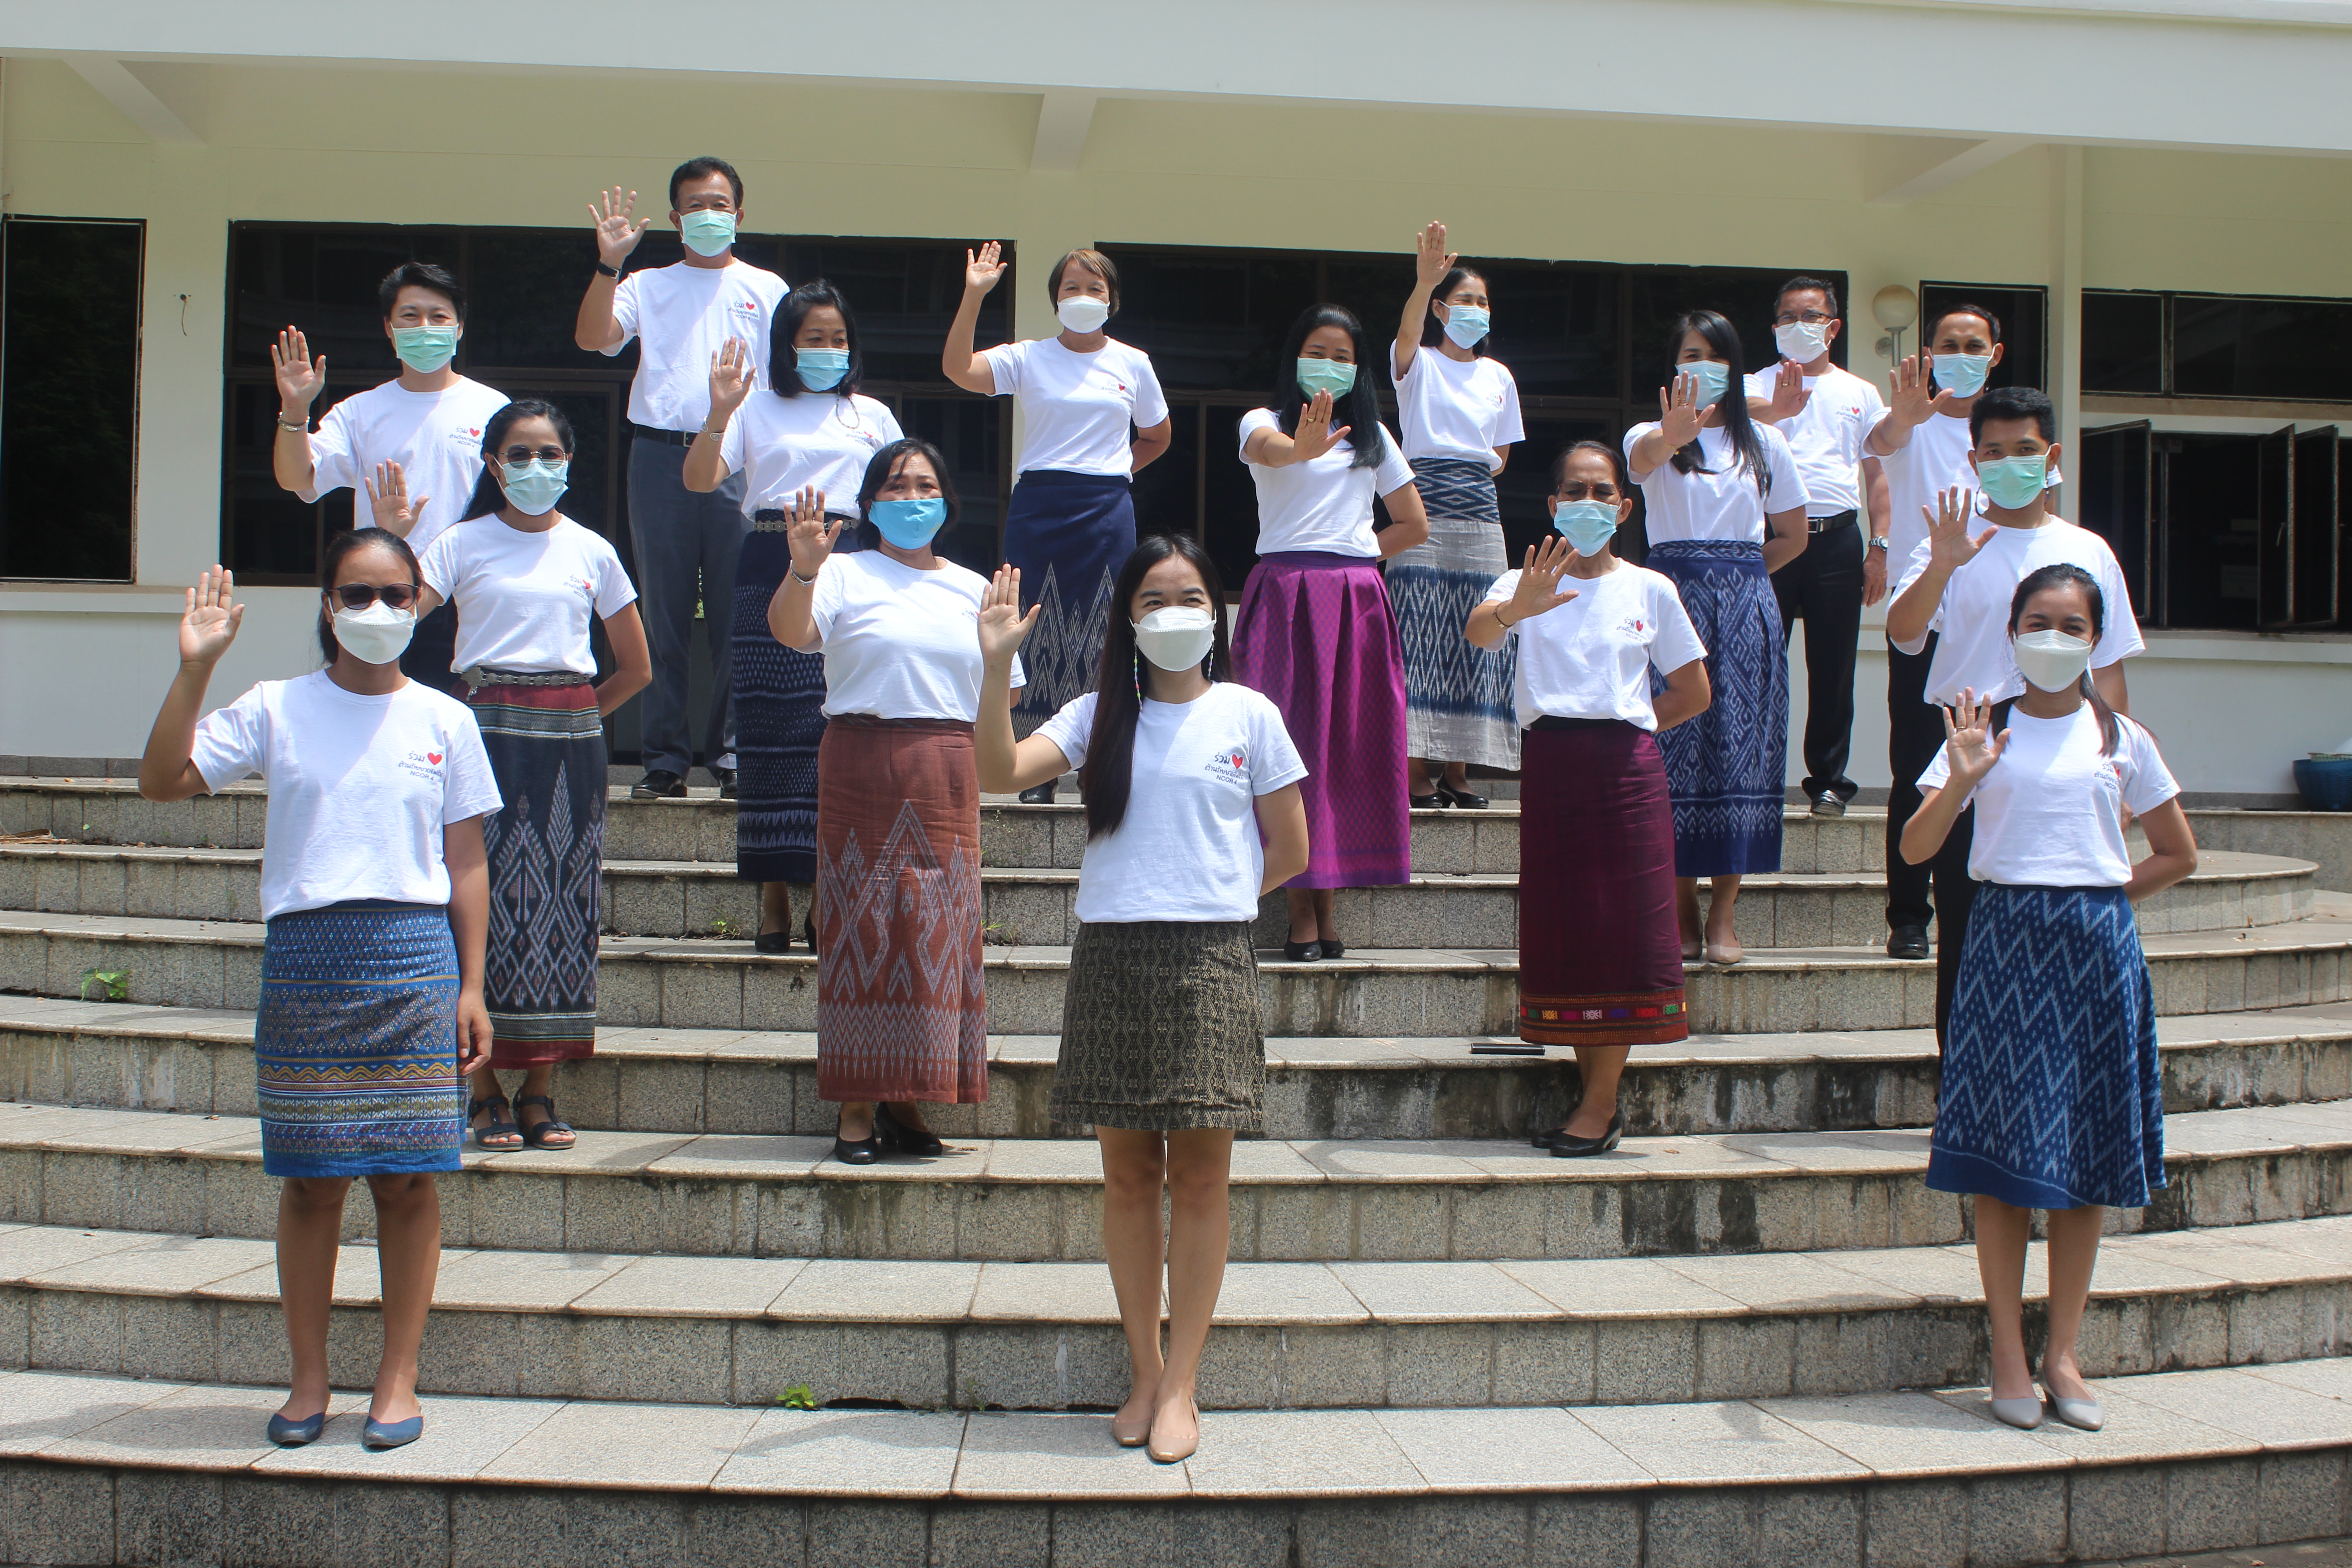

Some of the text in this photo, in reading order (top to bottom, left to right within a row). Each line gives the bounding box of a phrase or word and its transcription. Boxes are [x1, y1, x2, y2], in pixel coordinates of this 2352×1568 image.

[456, 425, 468, 434] ร่วม
[1624, 616, 1635, 627] ร่วม
[408, 750, 425, 762] ร่วม
[1214, 751, 1230, 764] ร่วม
